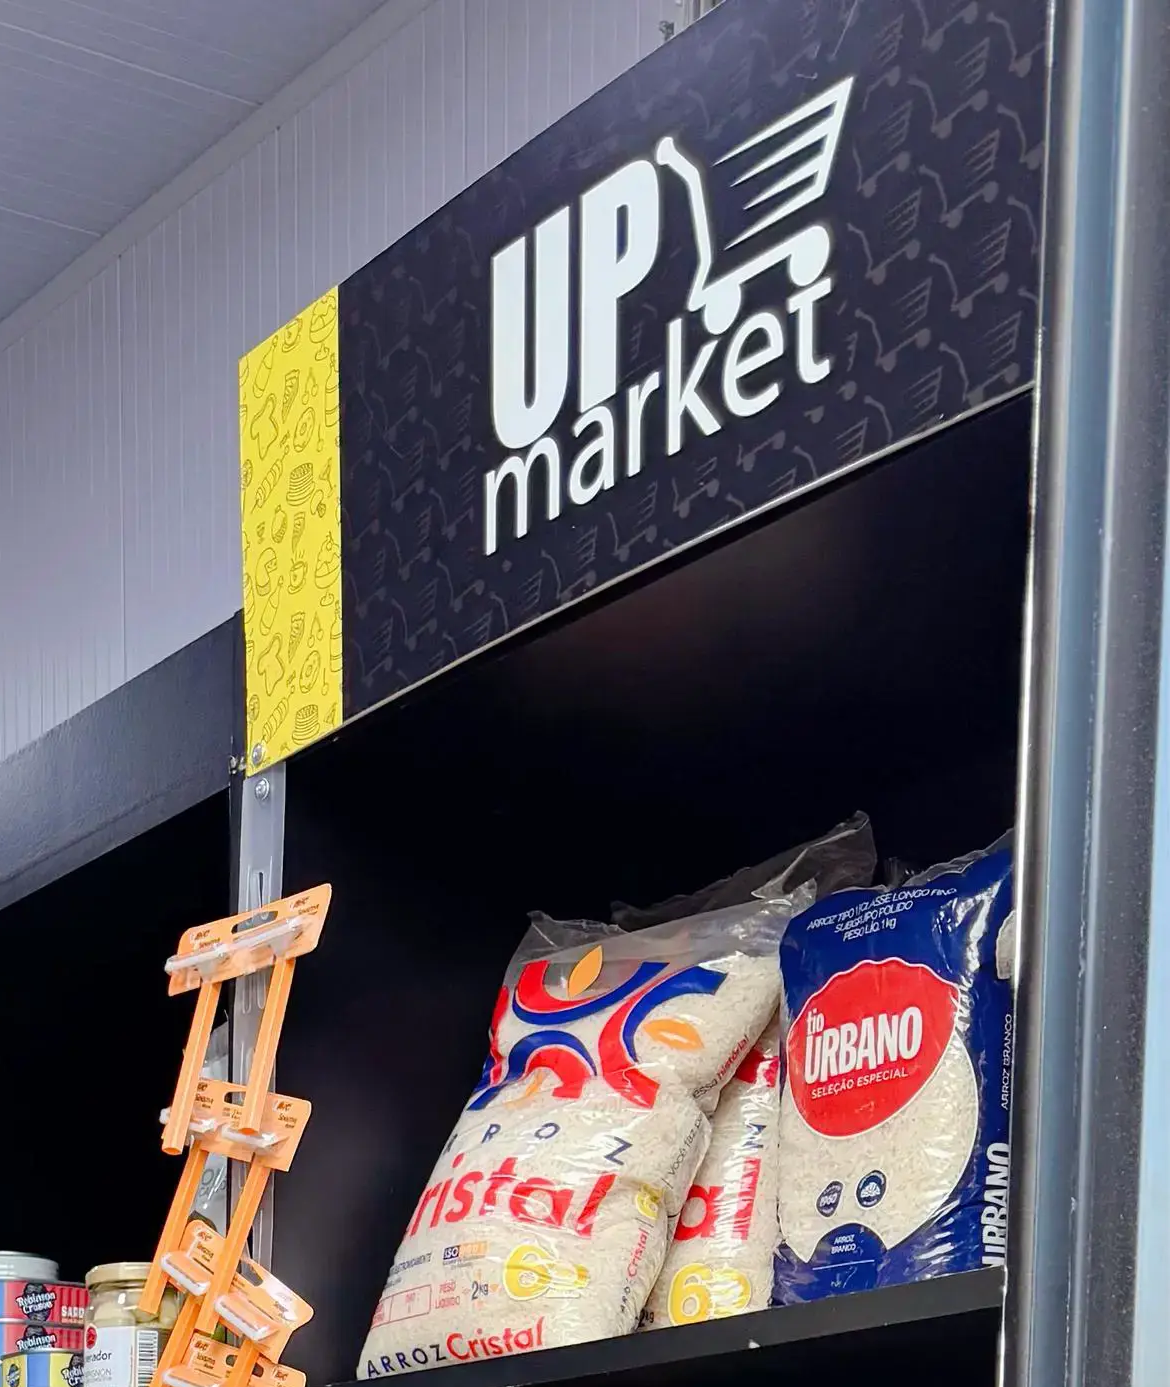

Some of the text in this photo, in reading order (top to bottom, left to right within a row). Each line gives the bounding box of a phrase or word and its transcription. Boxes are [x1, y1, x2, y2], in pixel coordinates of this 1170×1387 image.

[491, 159, 659, 450] UP
[484, 278, 833, 557] market
[878, 900, 914, 919] POLIDO
[892, 887, 930, 903] LONGO
[805, 1007, 825, 1035] tio
[804, 1006, 924, 1086] URBANO
[810, 1067, 909, 1101] SELEÇÃO ESPECIAL
[404, 1152, 618, 1240] ristal
[16, 1291, 56, 1308] Robinson
[365, 1316, 547, 1380] ARROZ Cristal
